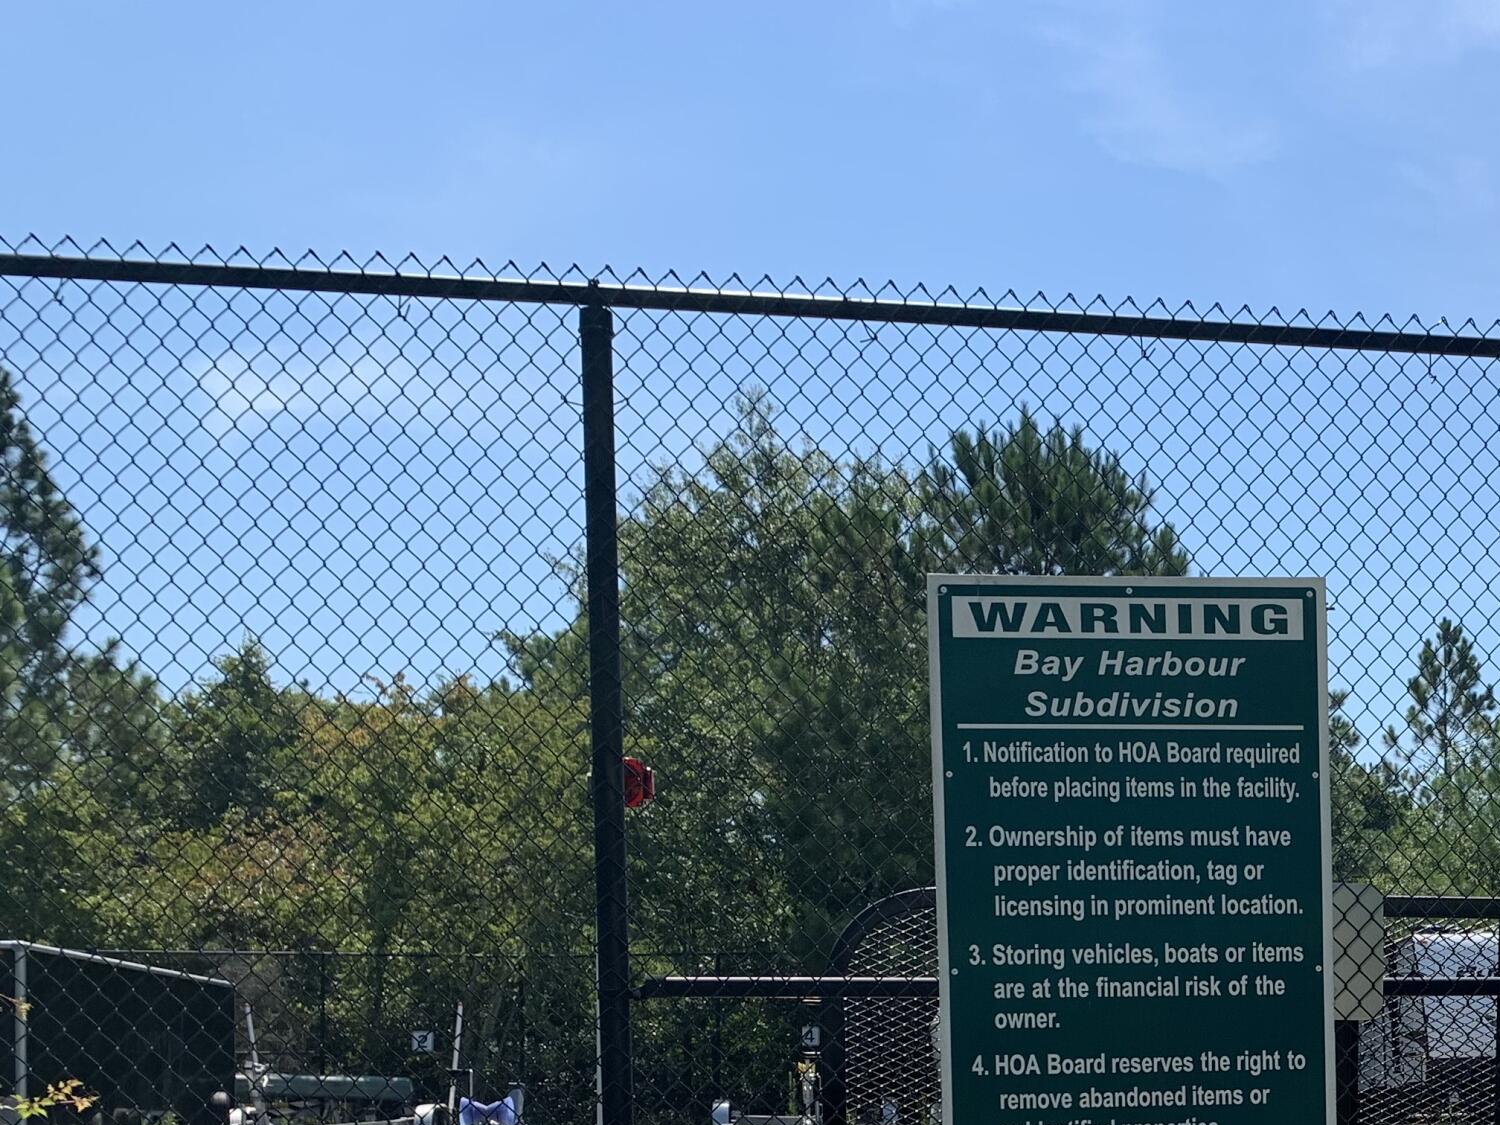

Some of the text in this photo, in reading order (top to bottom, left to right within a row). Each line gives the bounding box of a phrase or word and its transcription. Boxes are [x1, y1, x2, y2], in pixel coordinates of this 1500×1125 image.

[968, 601, 1289, 635] WARNING
[1014, 650, 1245, 681] Bay Harbour
[1025, 692, 1237, 717] Subdivision
[963, 742, 1299, 768] 1. Notification to HOA Board required
[990, 776, 1299, 803] before placing items in the facility.
[966, 825, 1290, 851] 2. Ownership of items must have
[995, 860, 1264, 886] proper identification, tag or
[995, 894, 1303, 921] licensing in prominent location.
[969, 942, 1303, 969] 3. Storing vehicles, boats or items
[995, 975, 1285, 998] are at the financial risk of the
[995, 1013, 1059, 1028] owner.
[418, 1035, 428, 1048] 2
[804, 1029, 815, 1043] 4
[972, 1050, 1305, 1075] 4. HOA Board reserves the right to
[1000, 1086, 1270, 1109] remove abandoned items or
